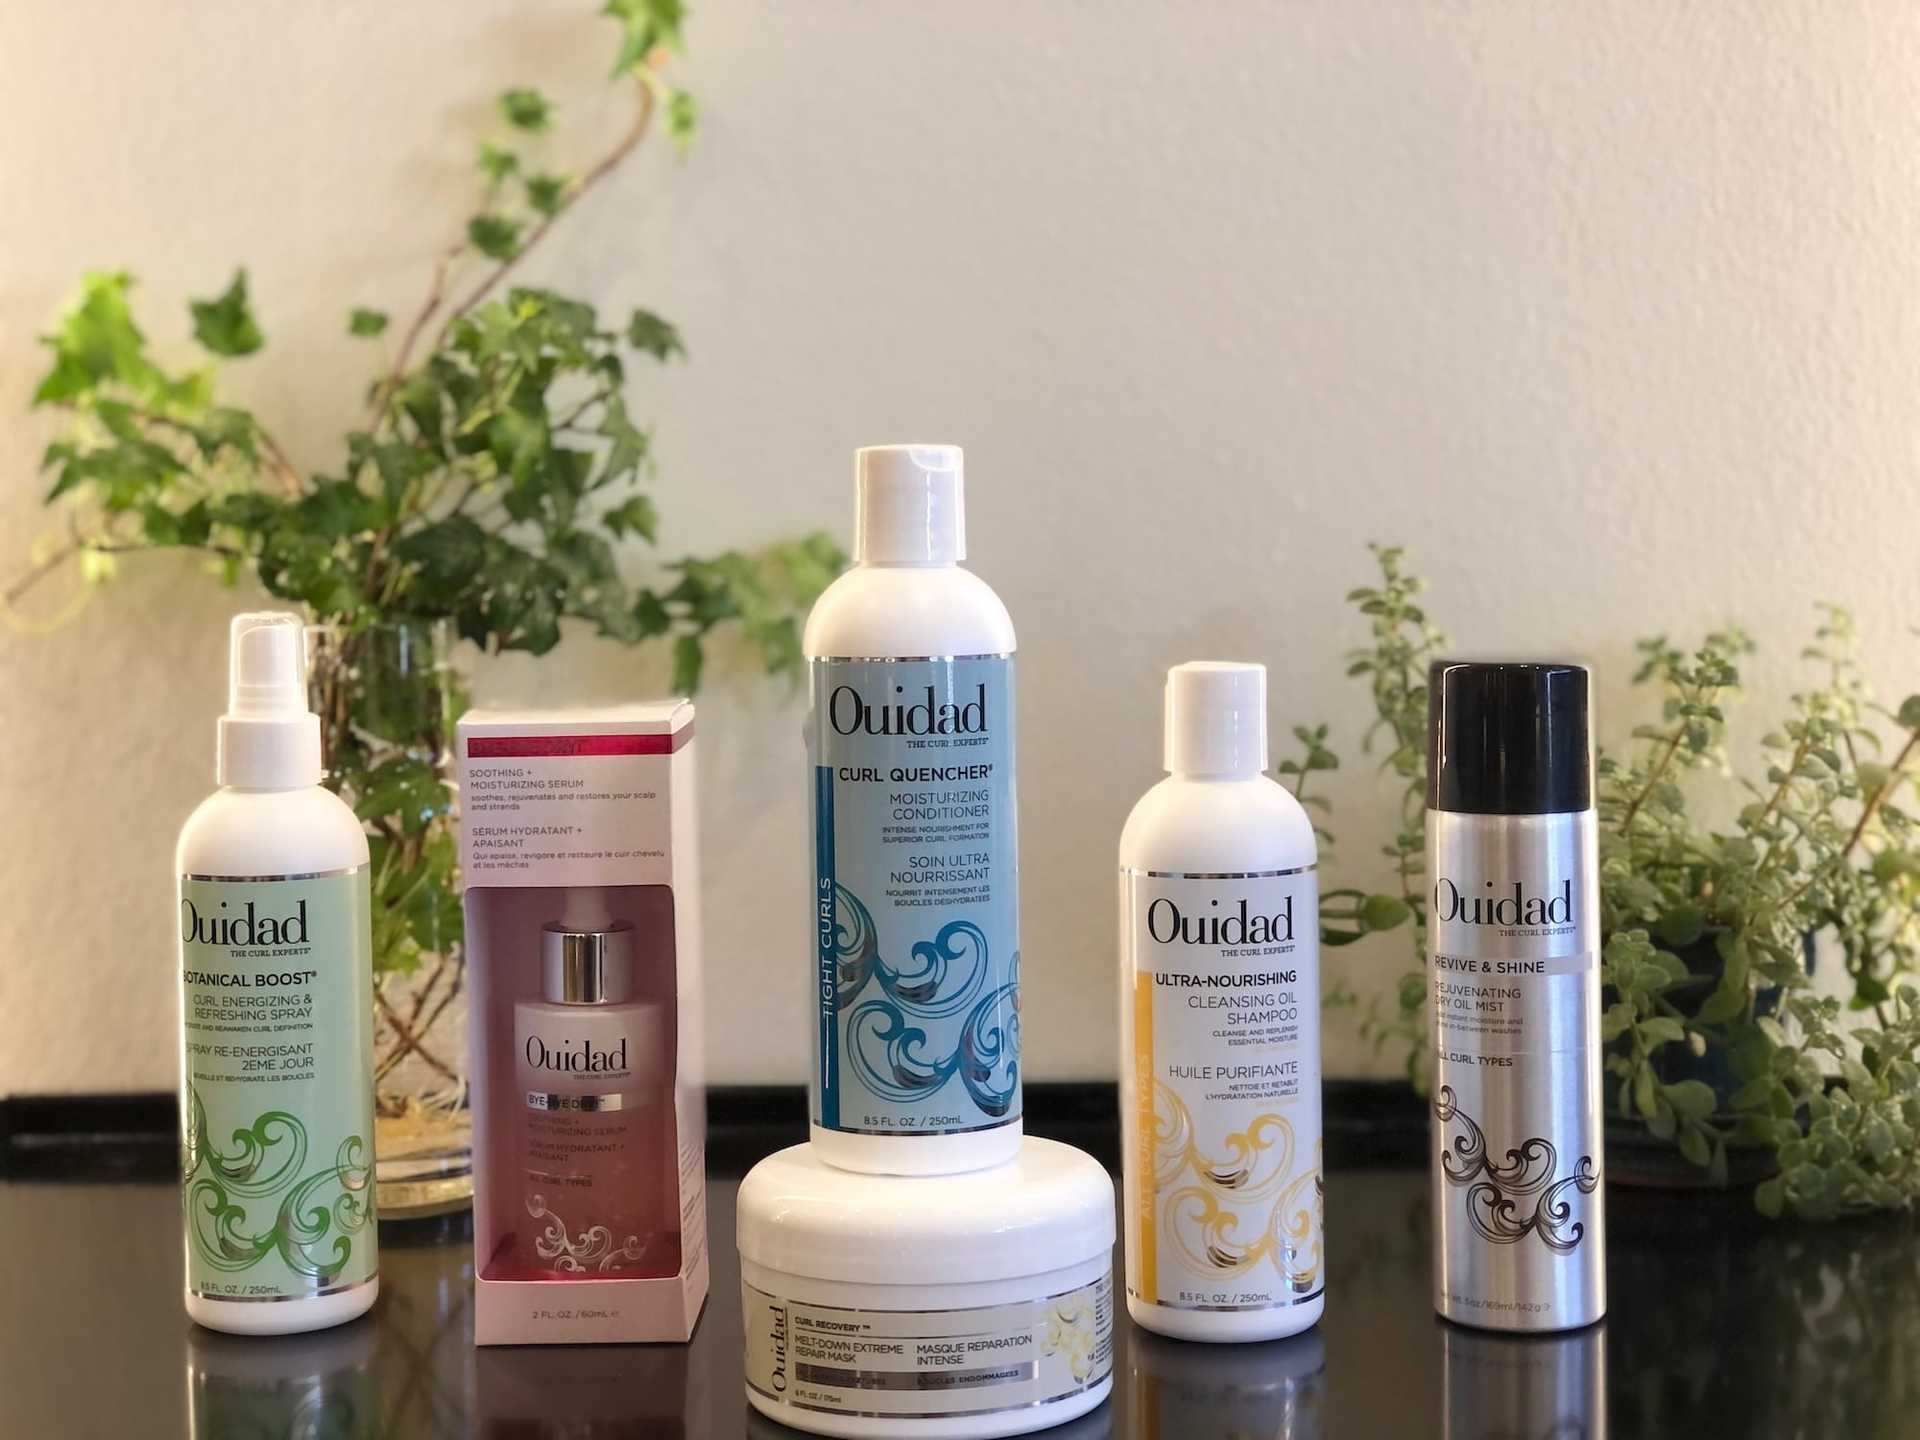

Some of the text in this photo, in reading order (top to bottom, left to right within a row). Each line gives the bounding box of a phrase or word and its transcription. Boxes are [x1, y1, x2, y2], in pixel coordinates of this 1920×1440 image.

[830, 683, 988, 736] Ouidad
[907, 740, 926, 748] THE
[469, 769, 524, 778] SOOTHING
[839, 767, 884, 782] CURL
[471, 780, 584, 790] MOISTURIZING SERUM
[508, 792, 556, 802] rejuvenates
[558, 792, 574, 800] and
[612, 793, 631, 801] your
[634, 791, 656, 800] scalp
[890, 790, 989, 805] MOISTURIZING
[471, 803, 520, 811] and strands
[893, 805, 989, 821] CONDITIONER
[511, 826, 573, 836] HYDRATANT
[883, 822, 989, 834] INTENSE NOURISHMENT FOR
[472, 839, 524, 848] APAISANT
[883, 832, 989, 844] SUPERIOR CURL FORMATION
[473, 852, 487, 860] Qui
[521, 852, 555, 861] revigore
[558, 851, 566, 859] et
[568, 851, 602, 859] restaure
[614, 850, 630, 858] cuir
[632, 850, 665, 858] chevelu
[909, 853, 989, 868] SOIN ULTRA
[473, 861, 481, 869] et
[483, 861, 495, 869] les
[890, 867, 990, 884] NOURRISSANT
[886, 888, 922, 897] NOURRIT
[925, 887, 976, 896] INTENSEMENT
[894, 898, 932, 907] BOUCLES
[1434, 877, 1573, 926] Ouidad
[182, 898, 309, 946] Ouidad
[1147, 895, 1294, 946] Ouidad
[1500, 929, 1517, 937] THE
[1518, 929, 1539, 937] CURL
[231, 950, 246, 958] THE
[248, 949, 271, 958] CURL
[820, 878, 833, 1017] TIGHT CURLS
[1221, 949, 1239, 957] THE
[1240, 948, 1261, 957] CURL
[1434, 955, 1545, 974] REVIVE & SHINE
[1156, 970, 1297, 988] ULTRA-NOURISHING
[1434, 981, 1521, 999] REJUVENATING
[193, 993, 312, 1008] CURL ENERGIZING &
[1188, 992, 1297, 1009] CLEANSING OIL
[1454, 999, 1472, 1010] OIL
[1475, 1001, 1504, 1012] MIST
[195, 1007, 312, 1021] REFRESHING SPRAY
[1227, 1007, 1298, 1025] SHAMPOO
[1507, 1016, 1523, 1025] and
[1212, 1025, 1298, 1038] CLEANSE AND REPLENISH
[1228, 1034, 1298, 1046] ESSENTIAL MOISTURE
[215, 1043, 313, 1058] RE-ENERGISANT
[526, 1035, 629, 1073] Ouidad
[242, 1057, 314, 1071] 2EME JOUR
[1450, 1052, 1475, 1065] CURL
[1477, 1056, 1513, 1067] TYPES
[1169, 1061, 1298, 1079] HUILE PURIFIANTE
[1229, 1083, 1259, 1091] NETTOIE
[1261, 1082, 1270, 1090] ET
[1264, 1087, 1298, 1098] NATURELLE
[528, 1093, 569, 1109] BYE-E
[864, 1116, 878, 1125] 8.5
[921, 1116, 926, 1127] /
[929, 1116, 962, 1126] 250mL
[1240, 1292, 1271, 1303] 250mL
[794, 1316, 814, 1328] CURL
[816, 1320, 861, 1332] RECOVERY
[769, 1305, 787, 1392] Ouidad
[794, 1334, 904, 1355] MELT-DOWN EXTREME
[917, 1334, 1033, 1354] MASQUE REPARATION
[795, 1346, 856, 1364] REPAIR MASK
[917, 1354, 964, 1366] INTENSE
